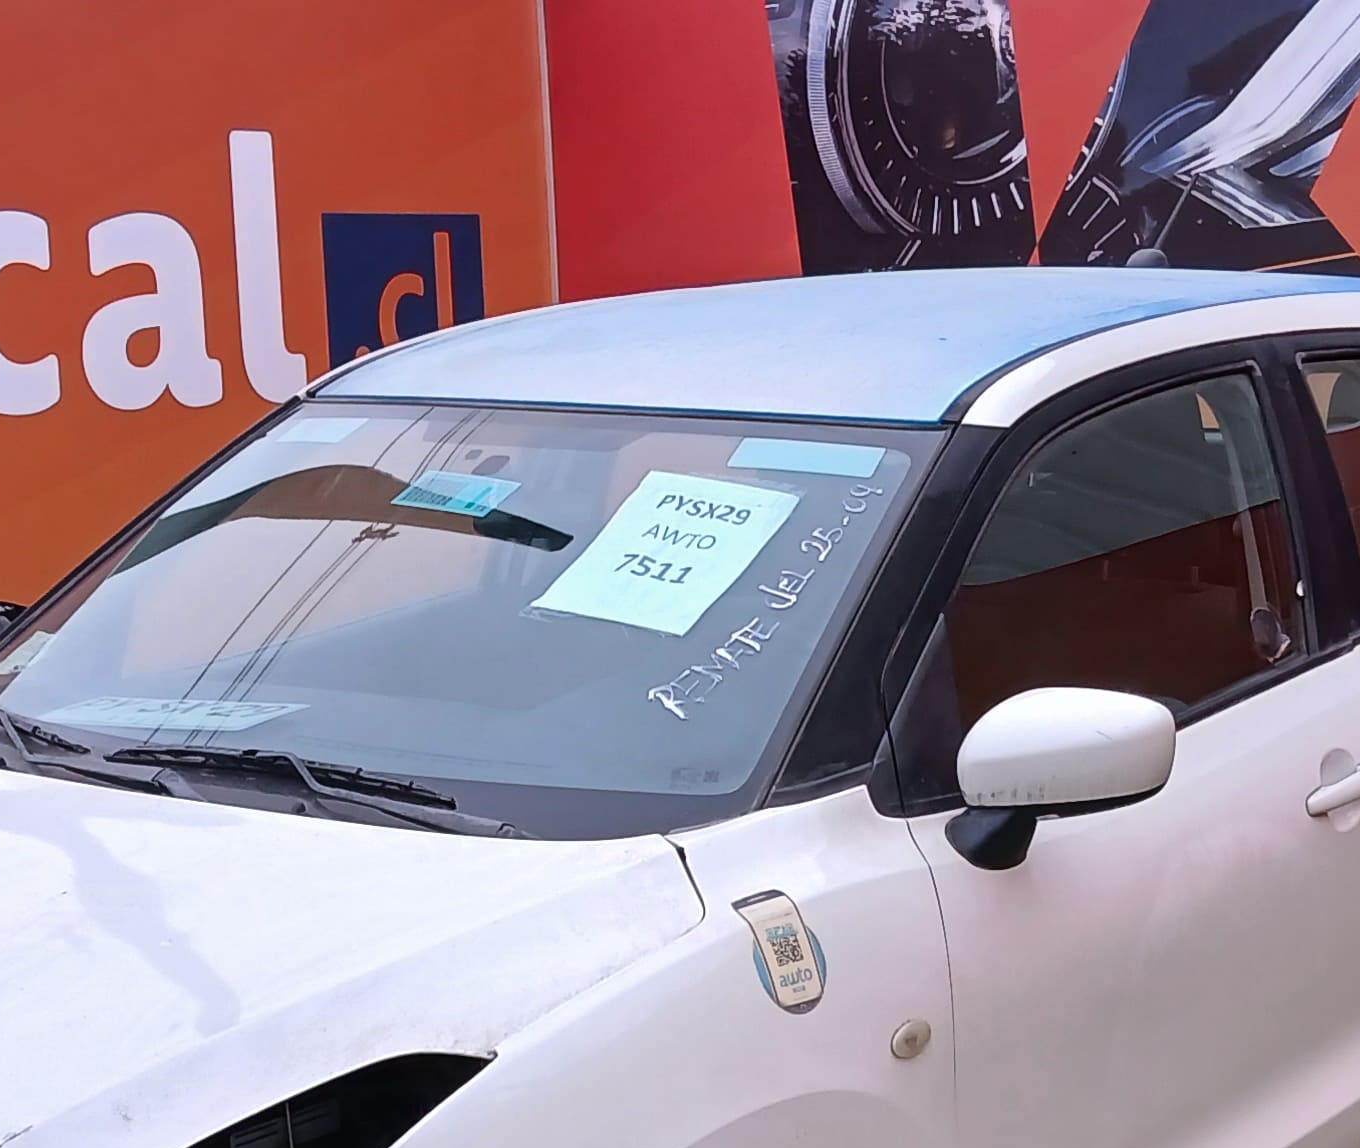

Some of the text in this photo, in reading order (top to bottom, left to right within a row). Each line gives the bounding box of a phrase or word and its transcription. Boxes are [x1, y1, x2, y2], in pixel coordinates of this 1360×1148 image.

[656, 494, 752, 526] PYSX29
[641, 523, 717, 550] AWTO
[614, 553, 694, 584] 7511
[648, 617, 780, 720] REMATE
[778, 967, 813, 988] awto
